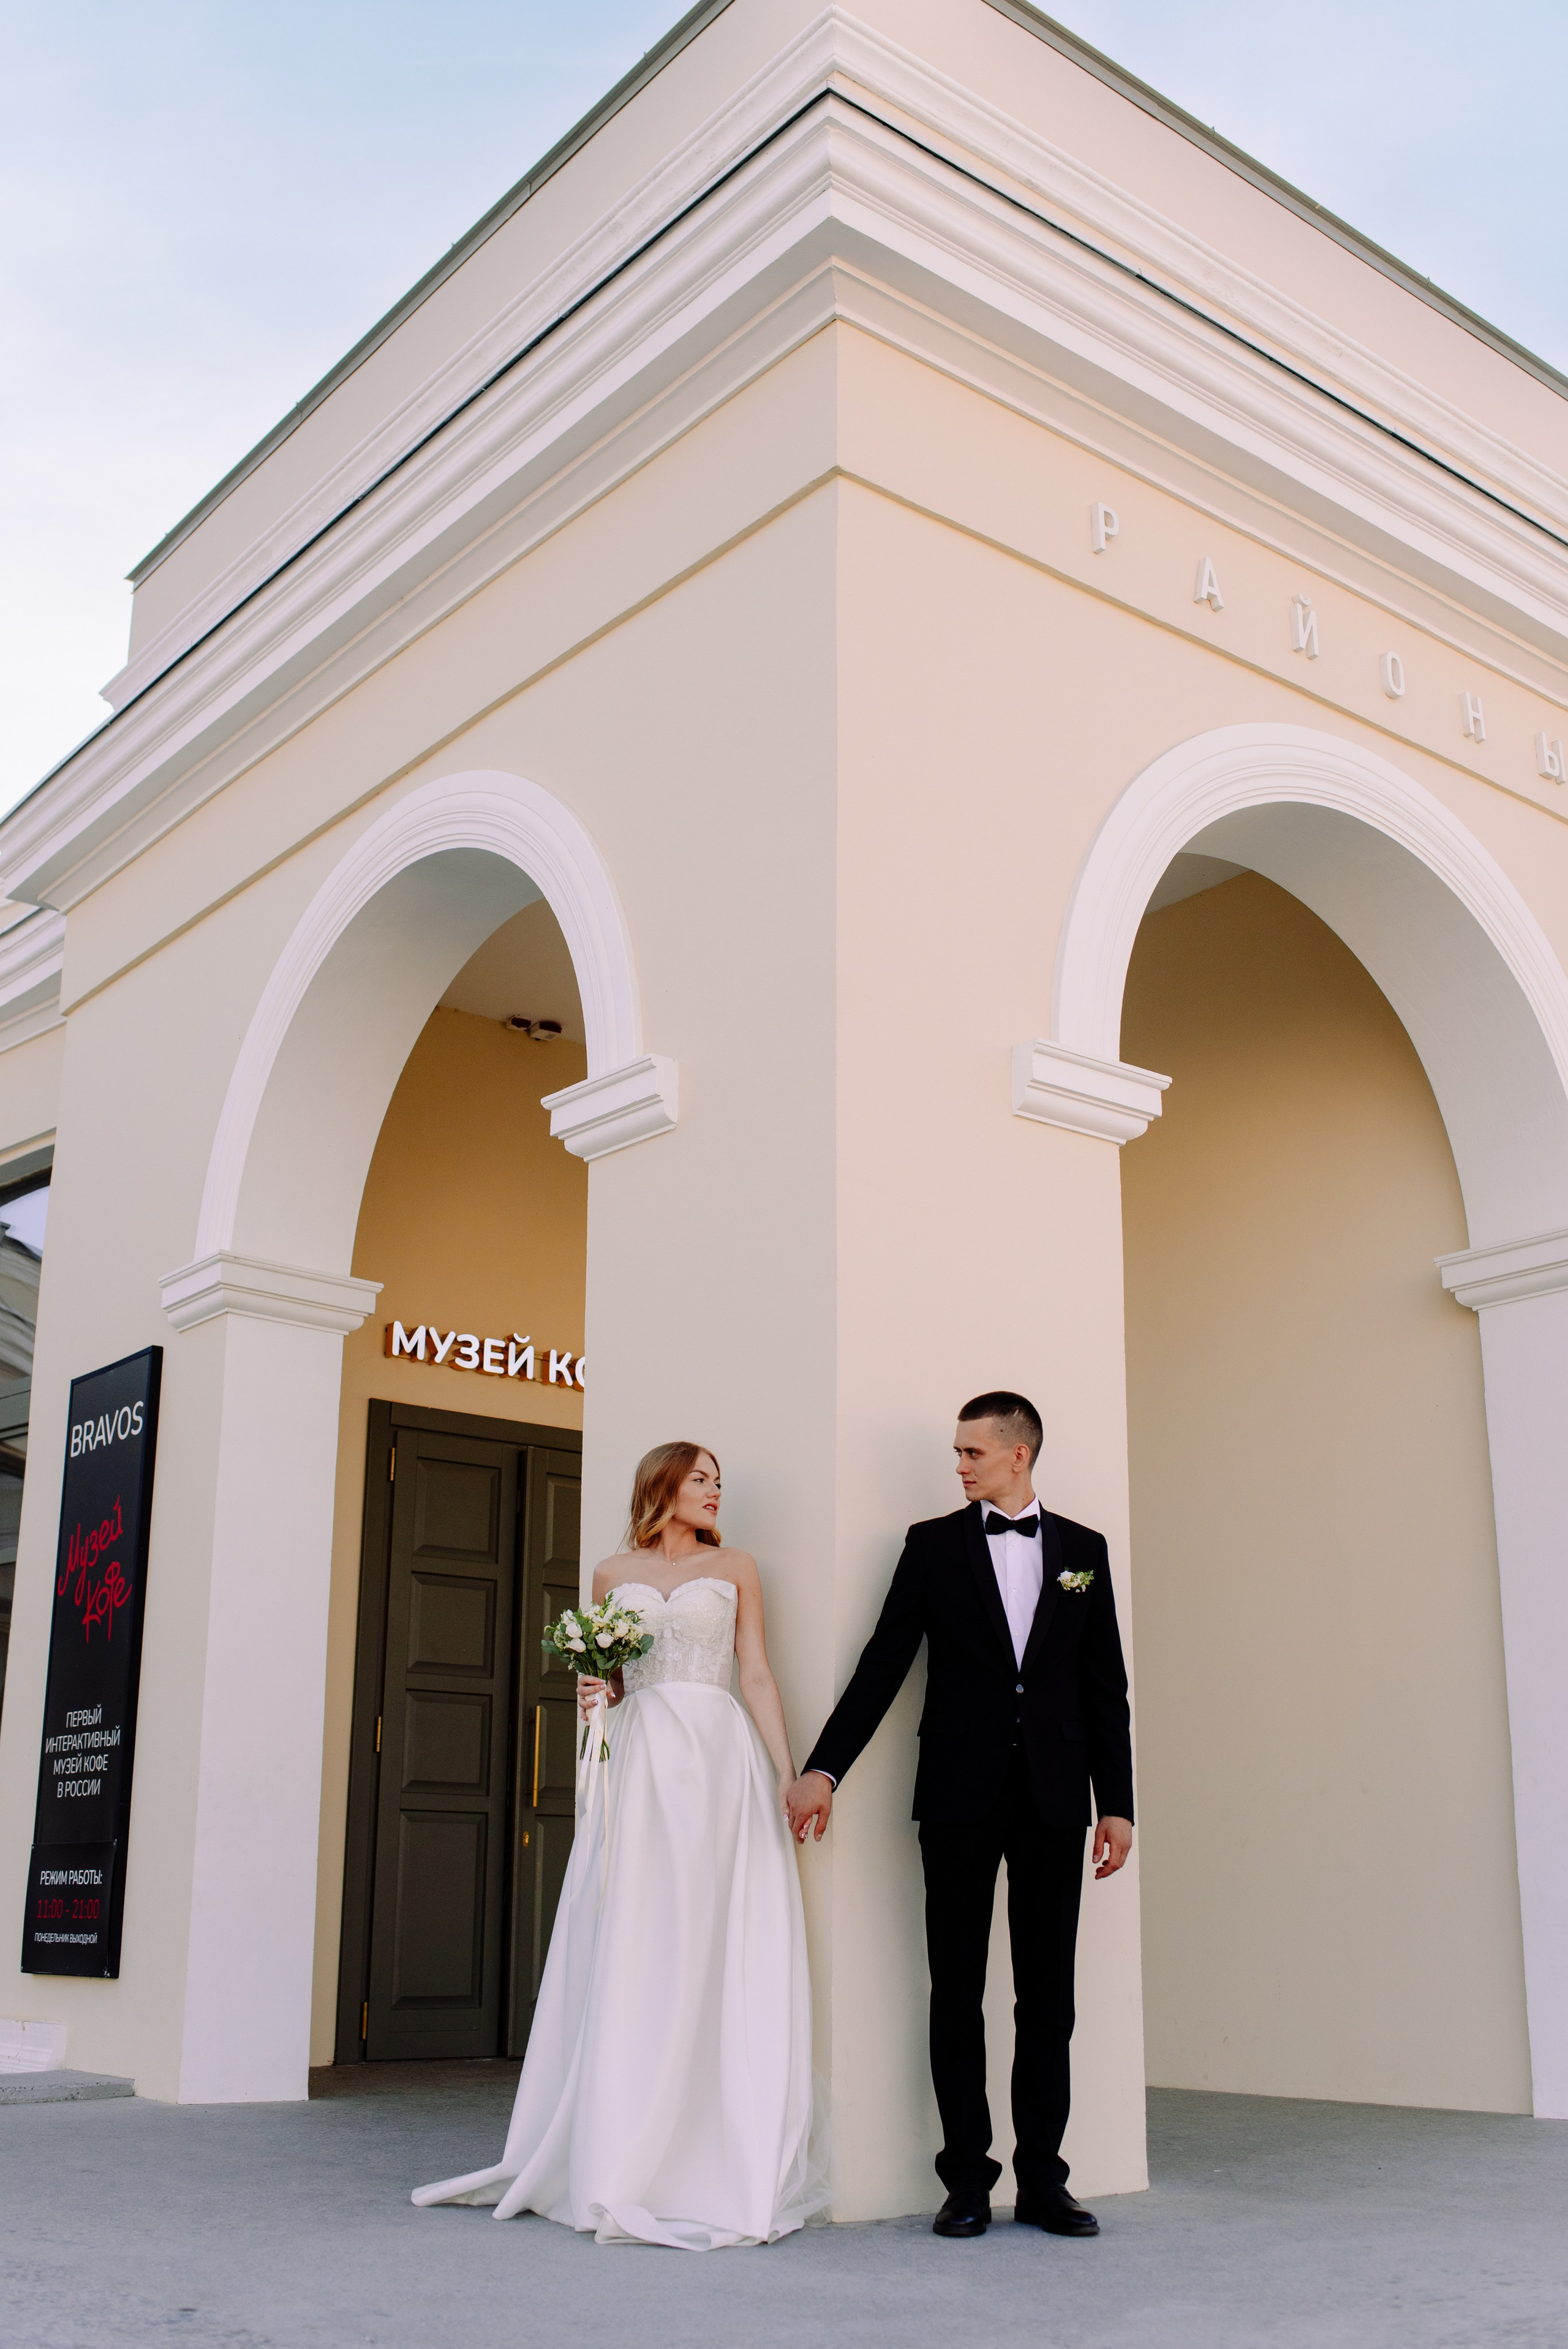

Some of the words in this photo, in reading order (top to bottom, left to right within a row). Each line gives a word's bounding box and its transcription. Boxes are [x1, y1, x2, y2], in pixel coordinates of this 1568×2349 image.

[391, 1320, 535, 1380] МУЗЕЙ
[70, 1400, 144, 1458] BRAVOS
[58, 1495, 124, 1607] Музей
[66, 1703, 102, 1728] ПЕРВЫЙ
[45, 1725, 121, 1754] ИНТЕРАКТИВНЫЙ
[53, 1752, 82, 1775] МУЗЕЙ
[83, 1754, 108, 1772] КОФЕ
[57, 1782, 64, 1798] В
[64, 1779, 100, 1797] РОССИИ
[40, 1870, 68, 1885] РЕЖИМ
[69, 1869, 102, 1885] РАБОТЫ:
[37, 1899, 63, 1918] 11:00
[72, 1899, 100, 1918] 21:00
[34, 1932, 69, 1944] ПОНЕДЕЛЬНИК
[69, 1932, 97, 1945] ВЫХОДНОЙ
